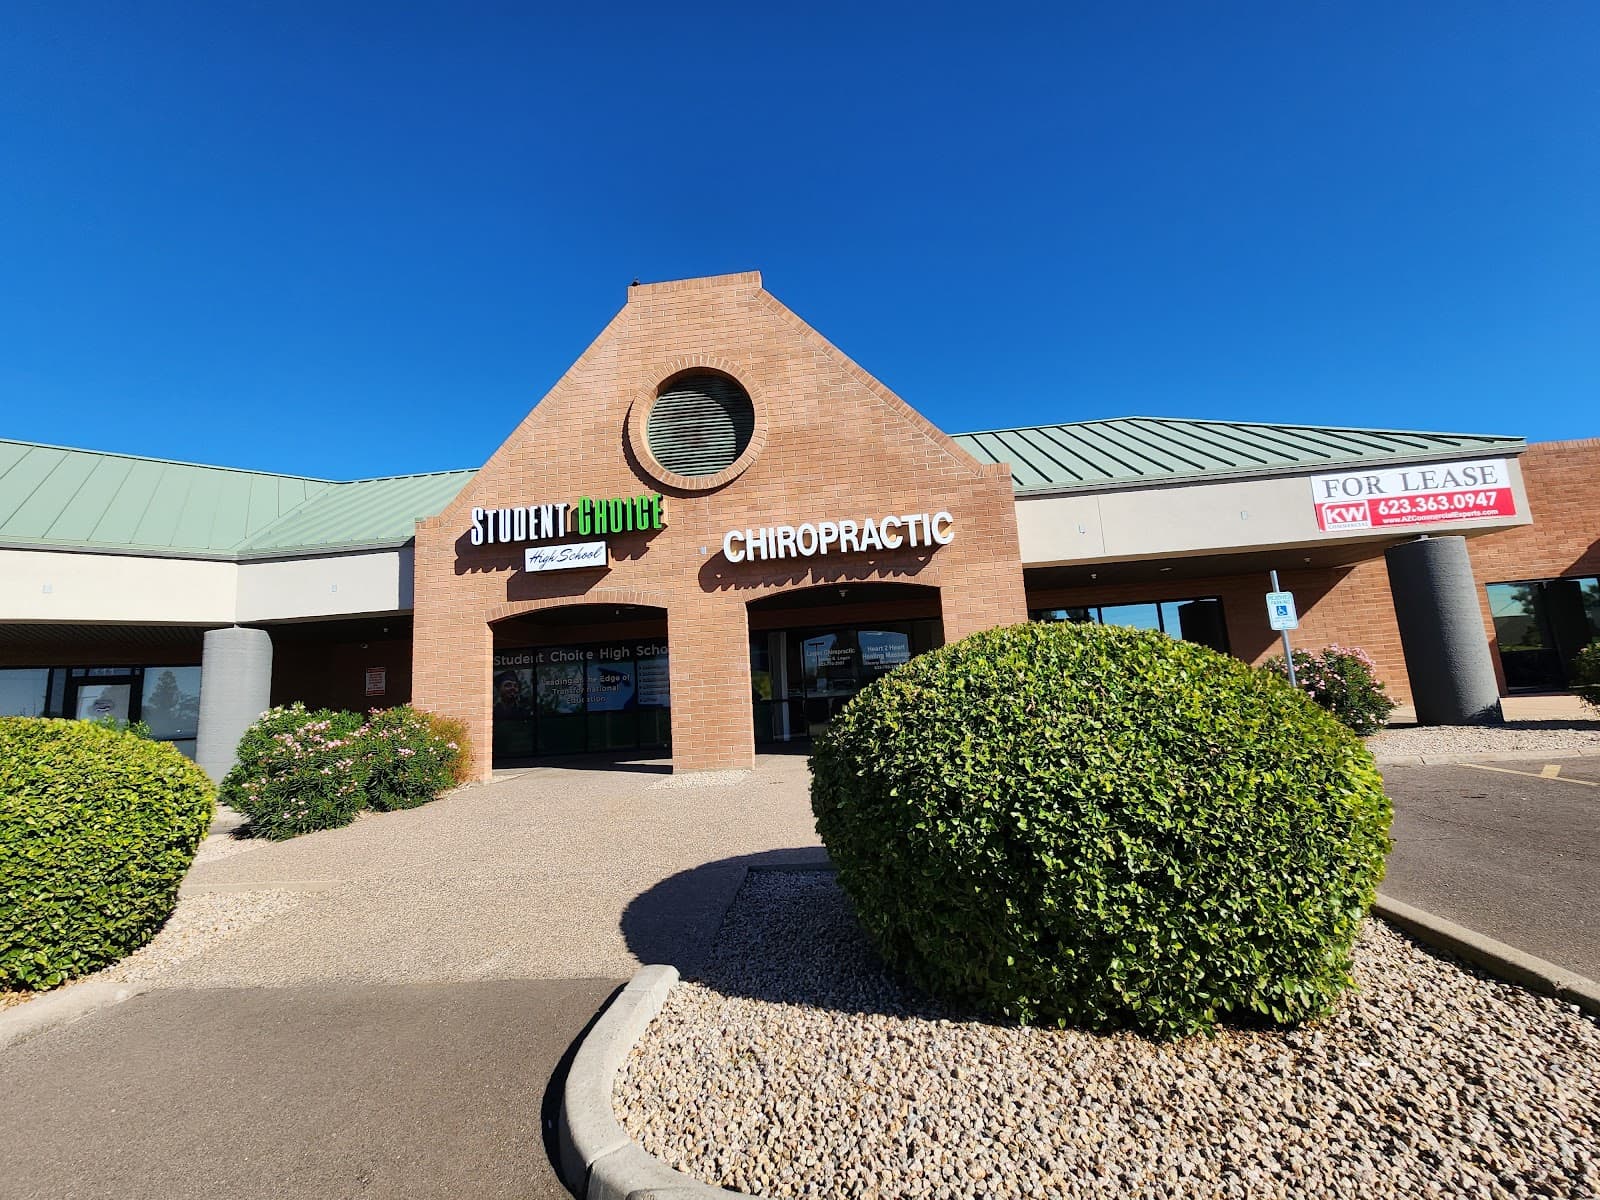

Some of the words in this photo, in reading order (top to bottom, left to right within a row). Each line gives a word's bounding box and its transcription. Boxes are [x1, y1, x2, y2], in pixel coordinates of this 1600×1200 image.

[1322, 475, 1387, 499] FOR
[1400, 465, 1498, 492] LEASE
[1326, 507, 1366, 524] KW
[1378, 491, 1497, 516] 623.363.0947
[470, 503, 569, 546] STUDENT
[577, 493, 663, 536] CHOICE
[723, 511, 955, 563] CHIROPRACTIC
[529, 548, 557, 569] High
[556, 545, 601, 564] School
[494, 652, 544, 667] Student
[550, 650, 594, 663] Choice
[600, 646, 630, 661] High
[600, 673, 621, 683] Edge
